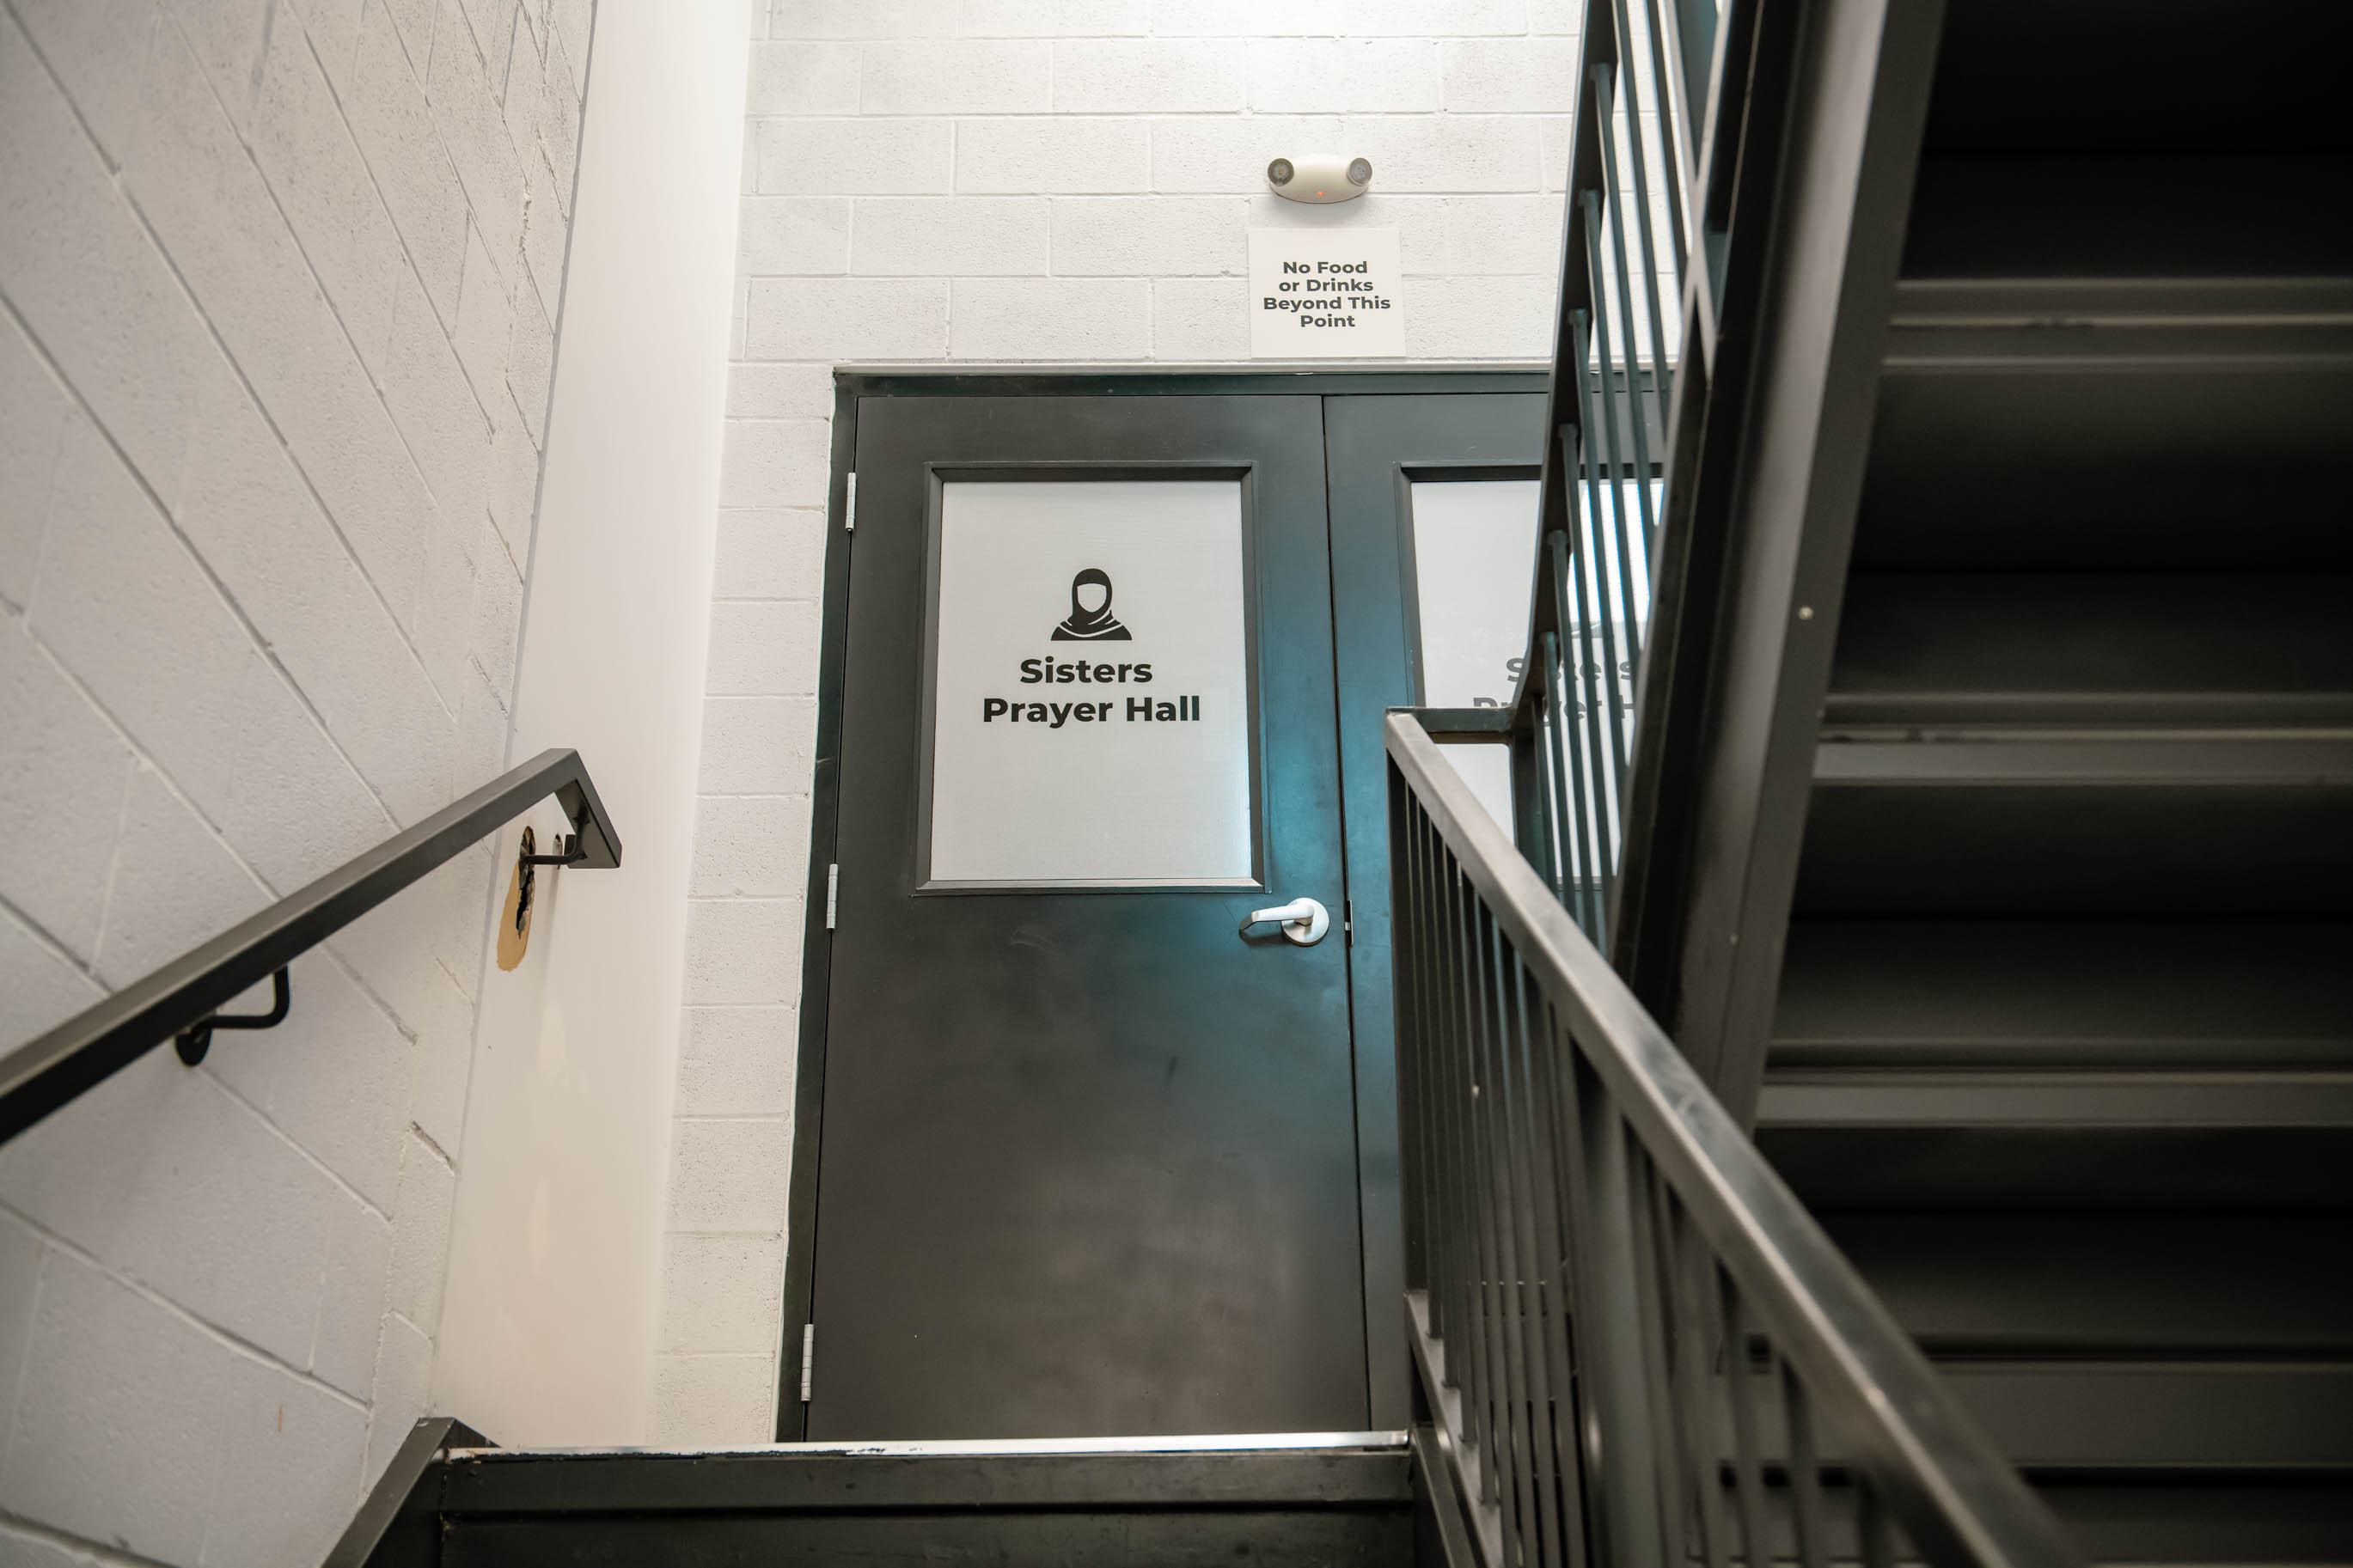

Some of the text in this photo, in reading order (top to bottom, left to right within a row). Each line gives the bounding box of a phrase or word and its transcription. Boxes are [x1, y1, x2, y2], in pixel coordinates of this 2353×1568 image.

[1283, 260, 1368, 274] No Food
[1278, 278, 1374, 292] or Drinks
[1263, 295, 1391, 313] Beyond This
[1300, 314, 1356, 328] Point
[1019, 656, 1153, 684] Sisters
[983, 695, 1201, 729] Prayer Hall
